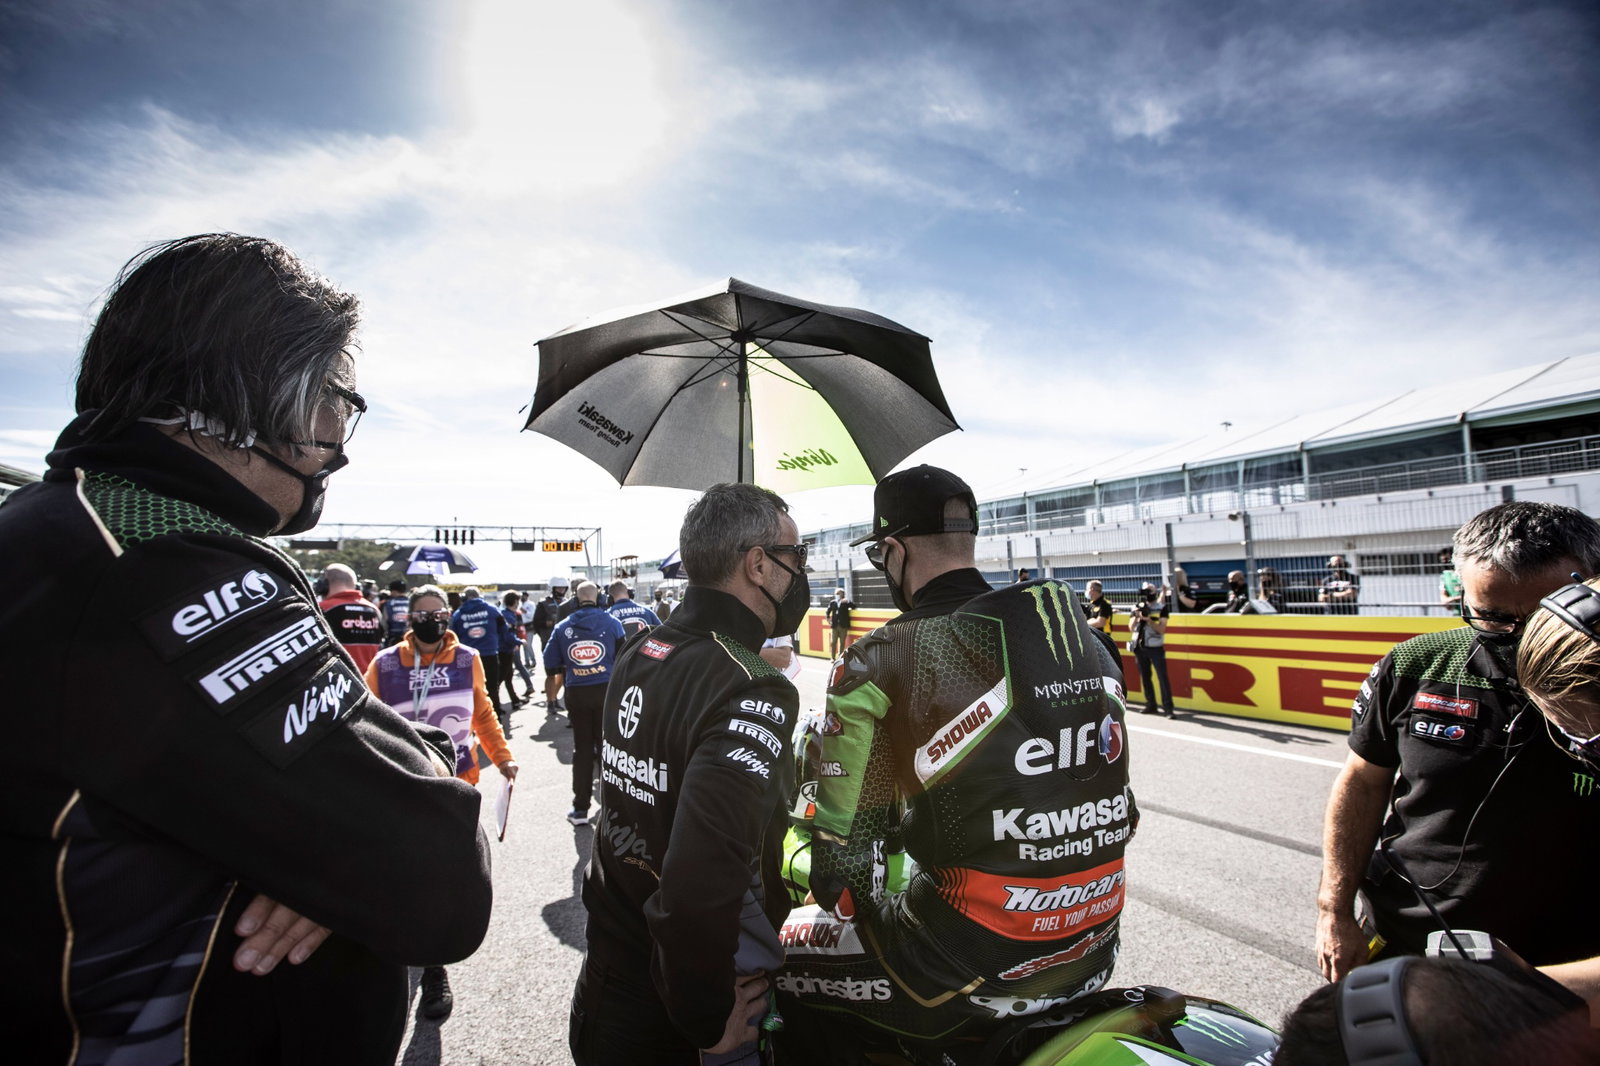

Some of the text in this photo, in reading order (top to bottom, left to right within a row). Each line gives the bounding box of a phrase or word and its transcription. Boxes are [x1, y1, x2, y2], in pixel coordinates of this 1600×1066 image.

[172, 581, 243, 636] elf
[199, 615, 325, 705] PIRELLI
[574, 648, 598, 658] PATA
[1034, 678, 1103, 699] MONSTER
[1051, 695, 1099, 708] ENERGY
[283, 671, 352, 744] Ninja
[740, 699, 773, 714] elf
[728, 718, 782, 758] PIRELLI
[926, 700, 993, 765] SHOWA
[1415, 721, 1446, 736] elf
[726, 747, 770, 779] Ninja
[1014, 721, 1096, 776] elf
[624, 779, 655, 807] Team
[1019, 836, 1093, 862] Racing
[1032, 916, 1061, 932] FUEL
[1064, 906, 1089, 928] YOUR
[775, 971, 892, 1001] alpinestars
